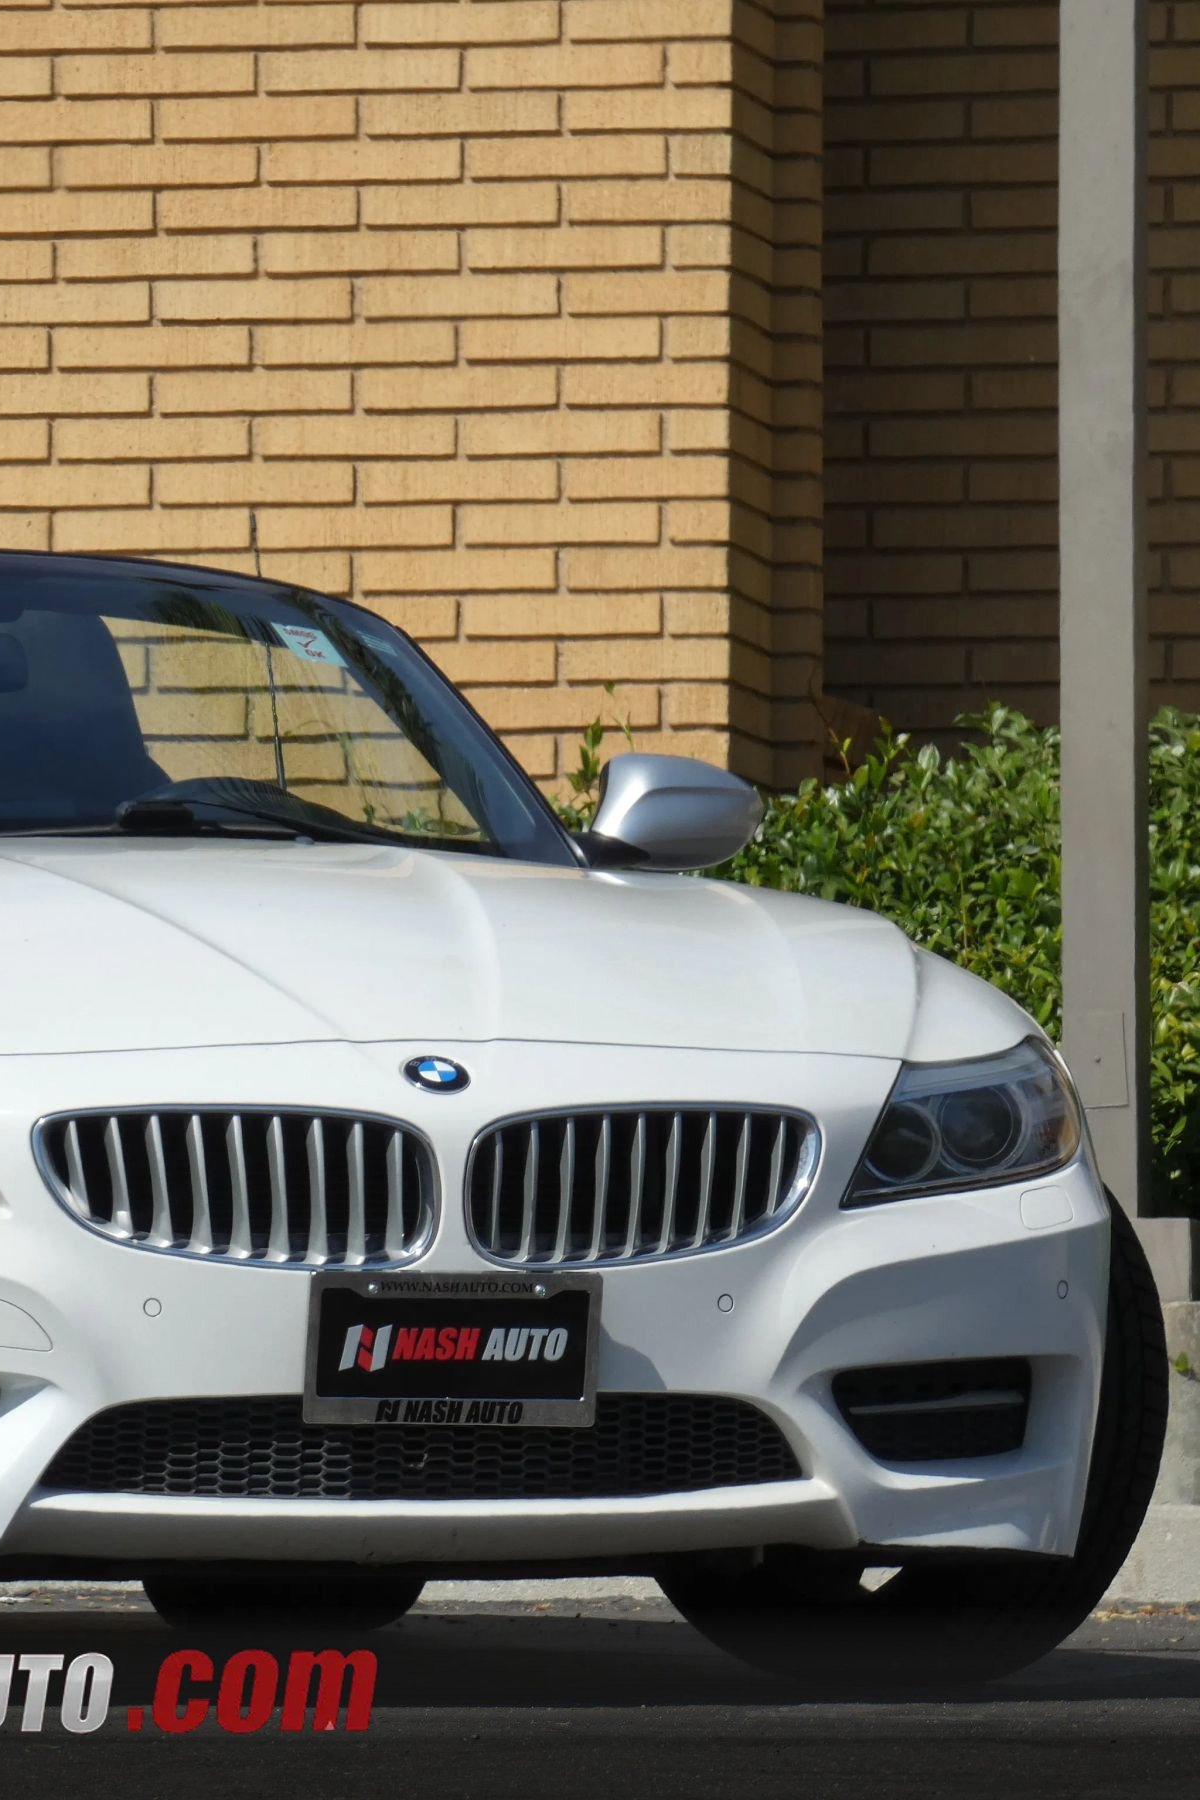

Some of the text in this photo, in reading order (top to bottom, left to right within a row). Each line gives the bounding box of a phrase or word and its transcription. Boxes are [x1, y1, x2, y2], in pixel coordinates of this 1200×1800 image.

[380, 1280, 534, 1295] WWW.NASHAUTO.COM
[392, 1327, 481, 1361] NASH
[481, 1327, 569, 1362] AUTO
[403, 1400, 464, 1424] NASH
[464, 1401, 524, 1424] AUTO
